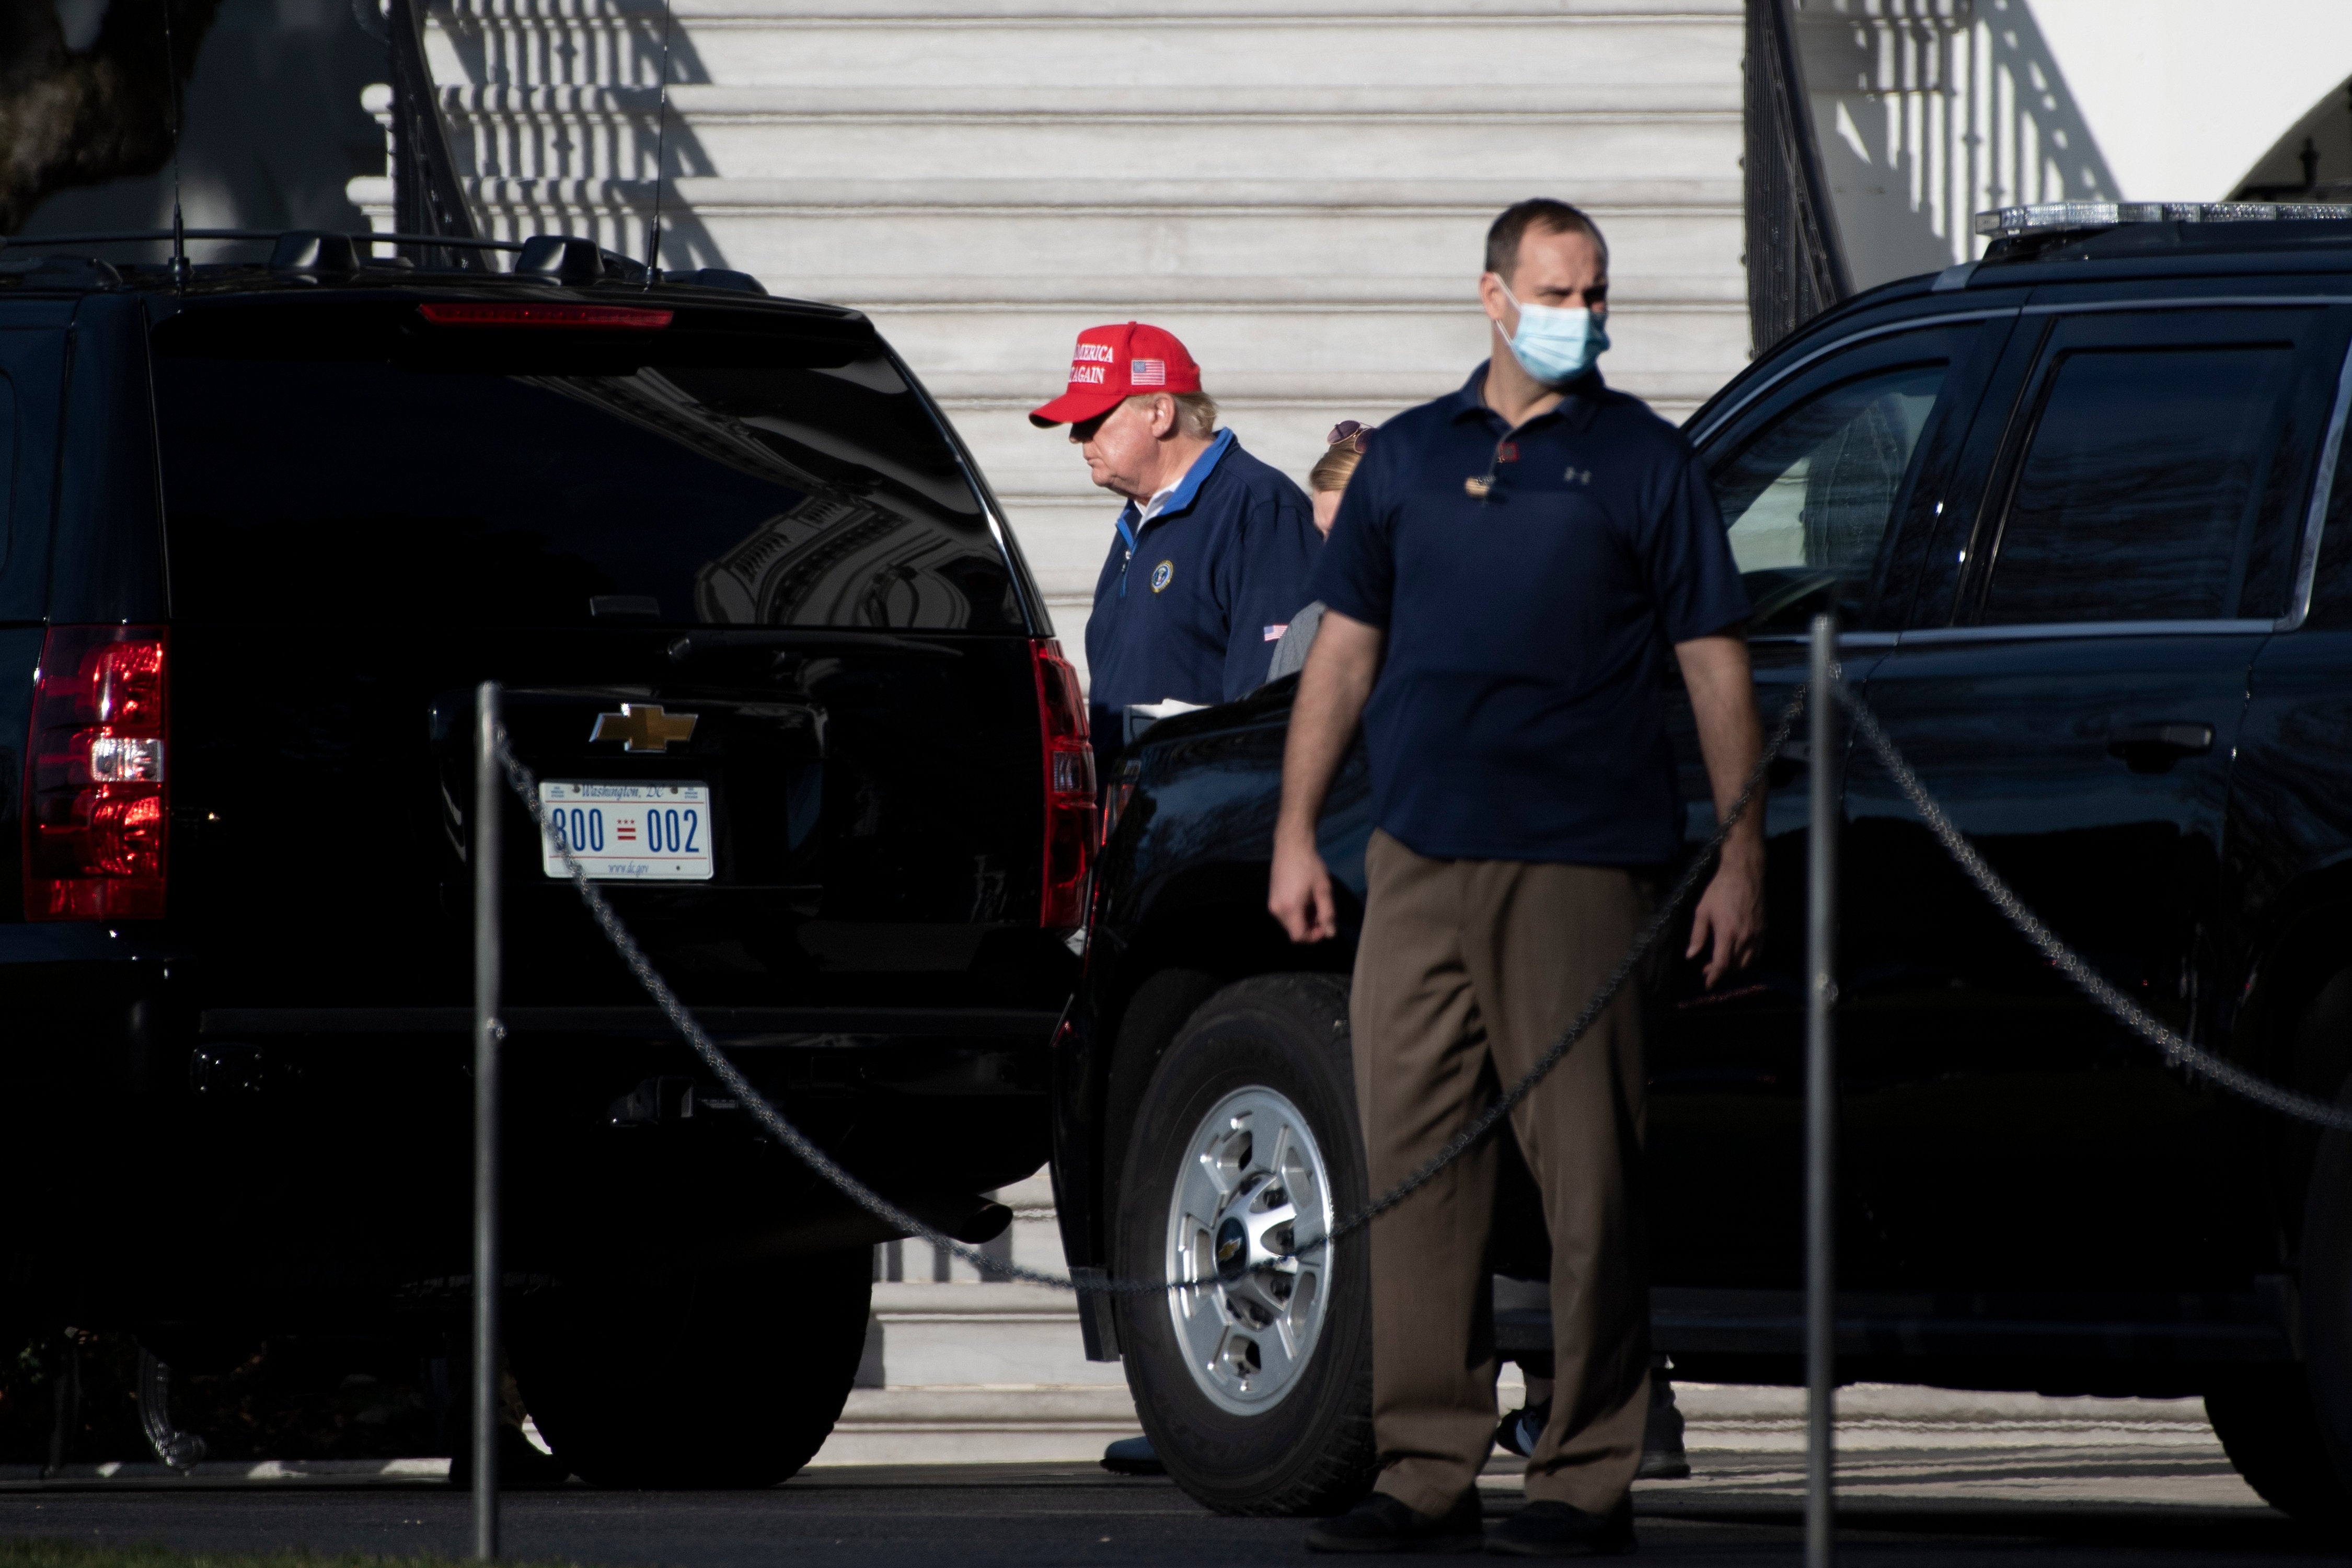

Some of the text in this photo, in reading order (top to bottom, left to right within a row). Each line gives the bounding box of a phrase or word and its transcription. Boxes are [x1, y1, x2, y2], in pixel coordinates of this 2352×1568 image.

[1074, 344, 1113, 363] MERICA
[1072, 366, 1105, 384] AGAIN
[646, 786, 664, 798] DC
[552, 809, 699, 852] 800 002
